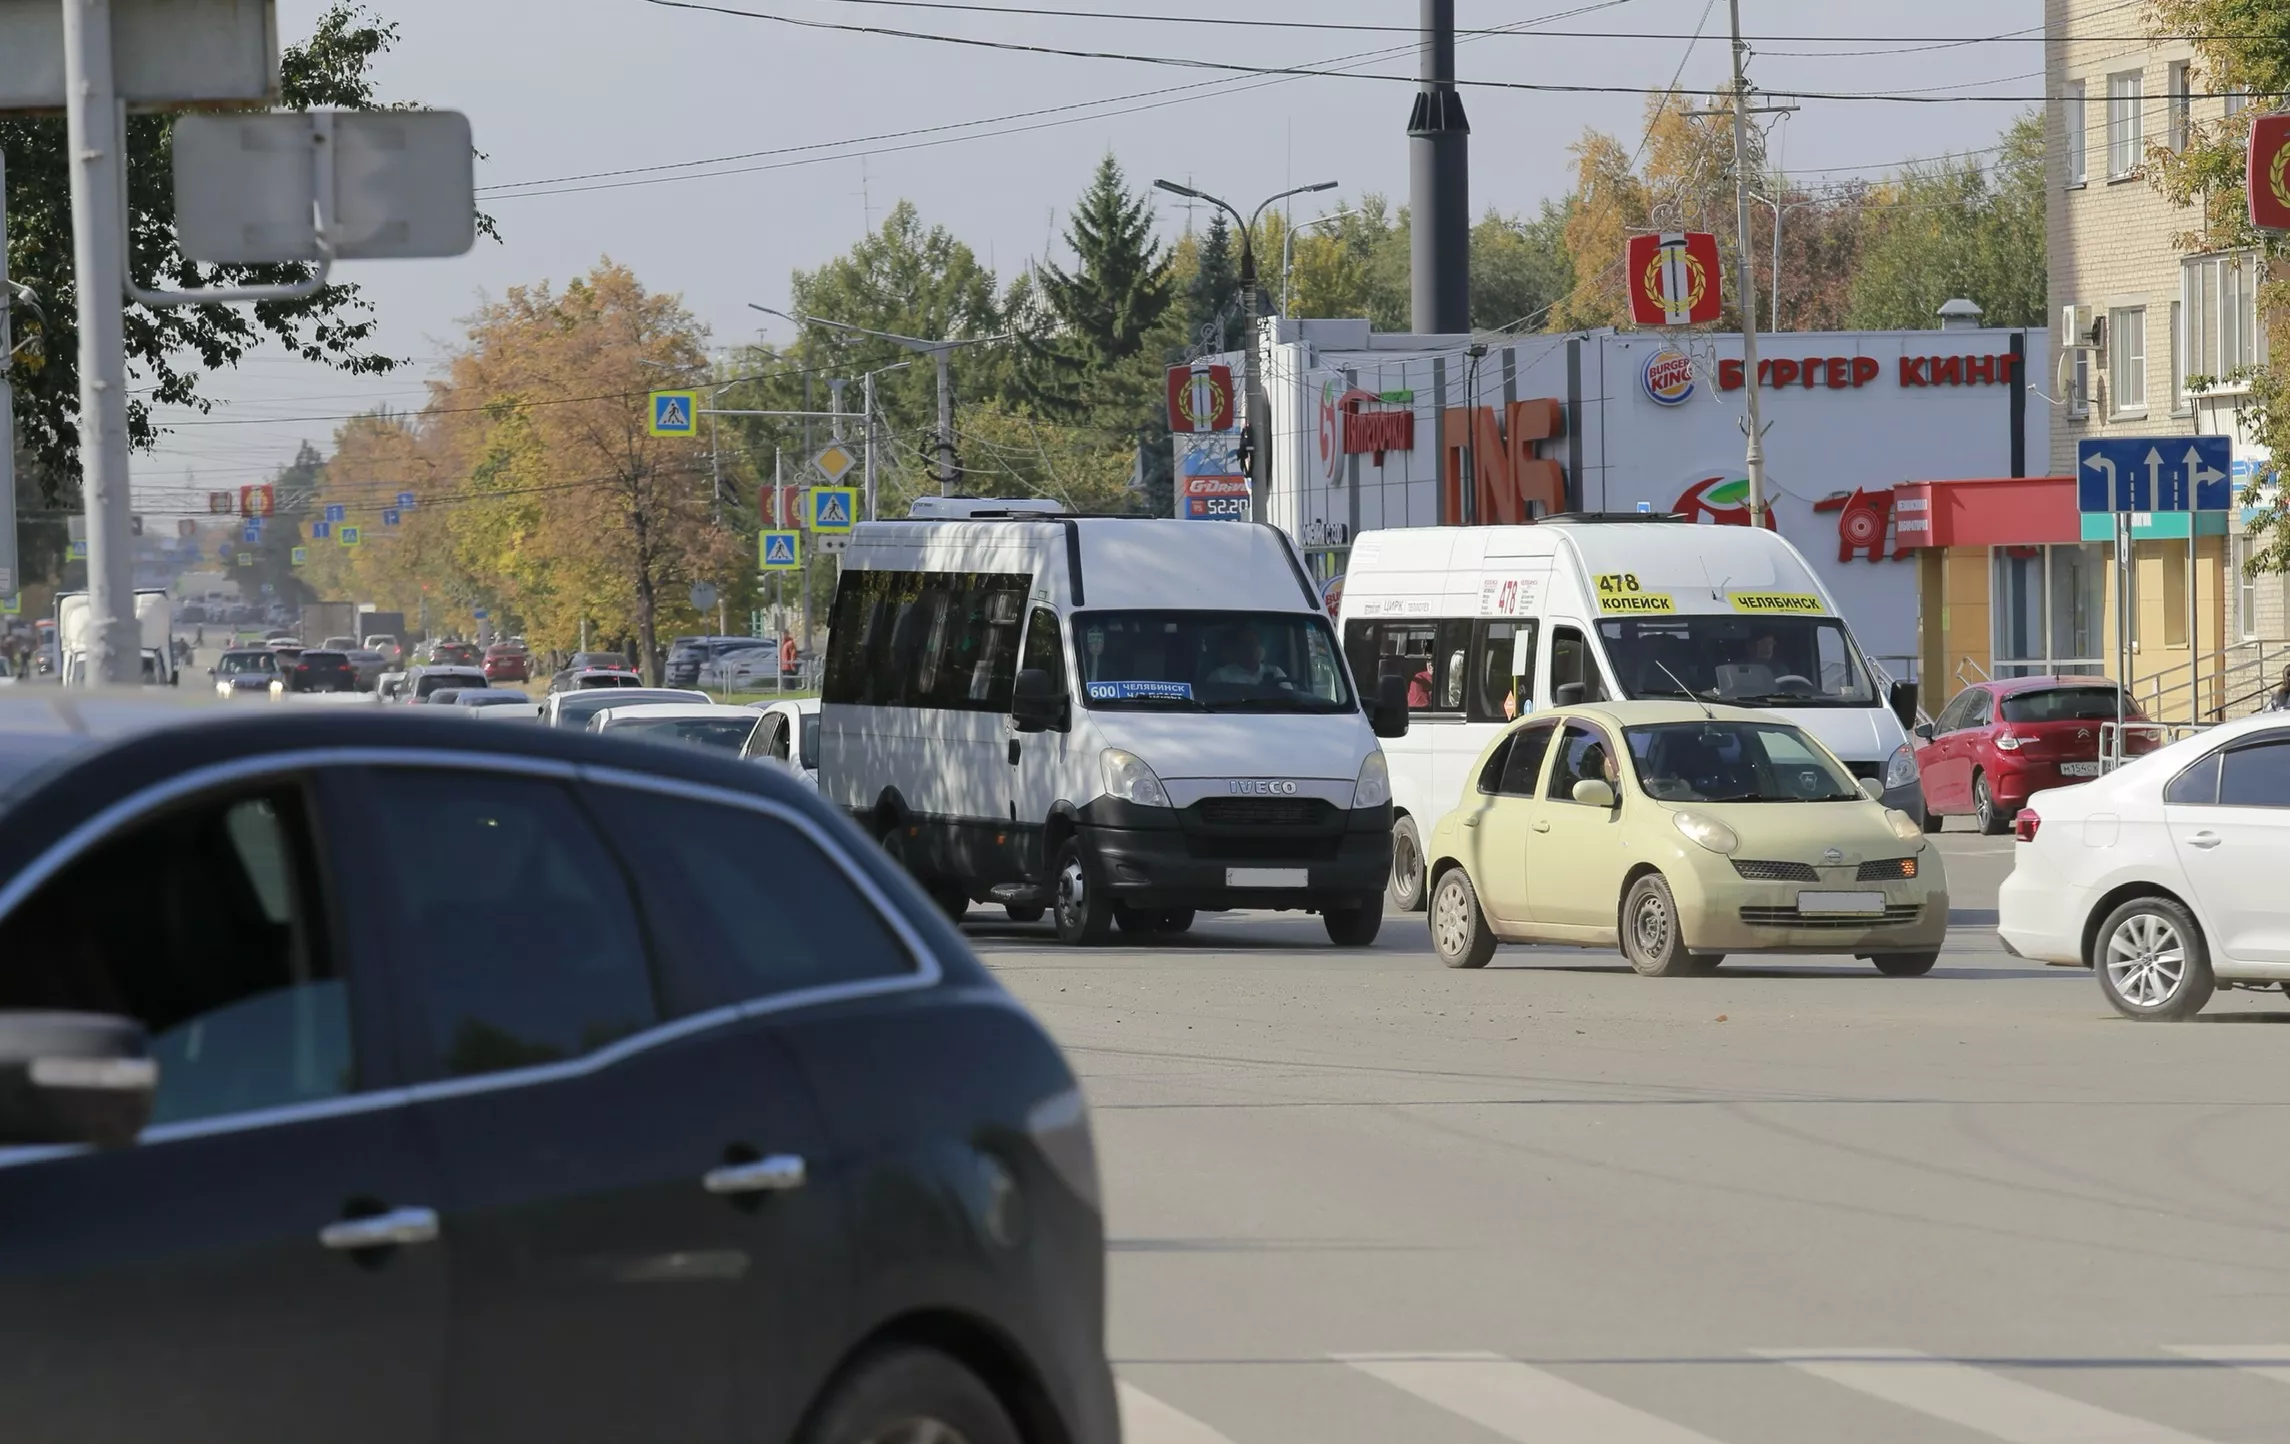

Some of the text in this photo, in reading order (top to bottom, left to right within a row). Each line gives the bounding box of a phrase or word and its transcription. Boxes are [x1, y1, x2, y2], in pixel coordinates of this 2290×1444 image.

[1649, 358, 1690, 379] BURGER
[1899, 353, 2021, 387] КИНГ
[1651, 367, 1693, 392] KING
[1600, 574, 1640, 593] 478
[1499, 580, 1518, 615] 478
[1602, 596, 1670, 610] КОПЕЙСК
[1738, 596, 1820, 610] ЧЕЛЯБИНСК
[1090, 686, 1116, 698] 600
[1123, 683, 1185, 692] ЧЕЛЯБИНСК
[1229, 780, 1298, 795] IVECO
